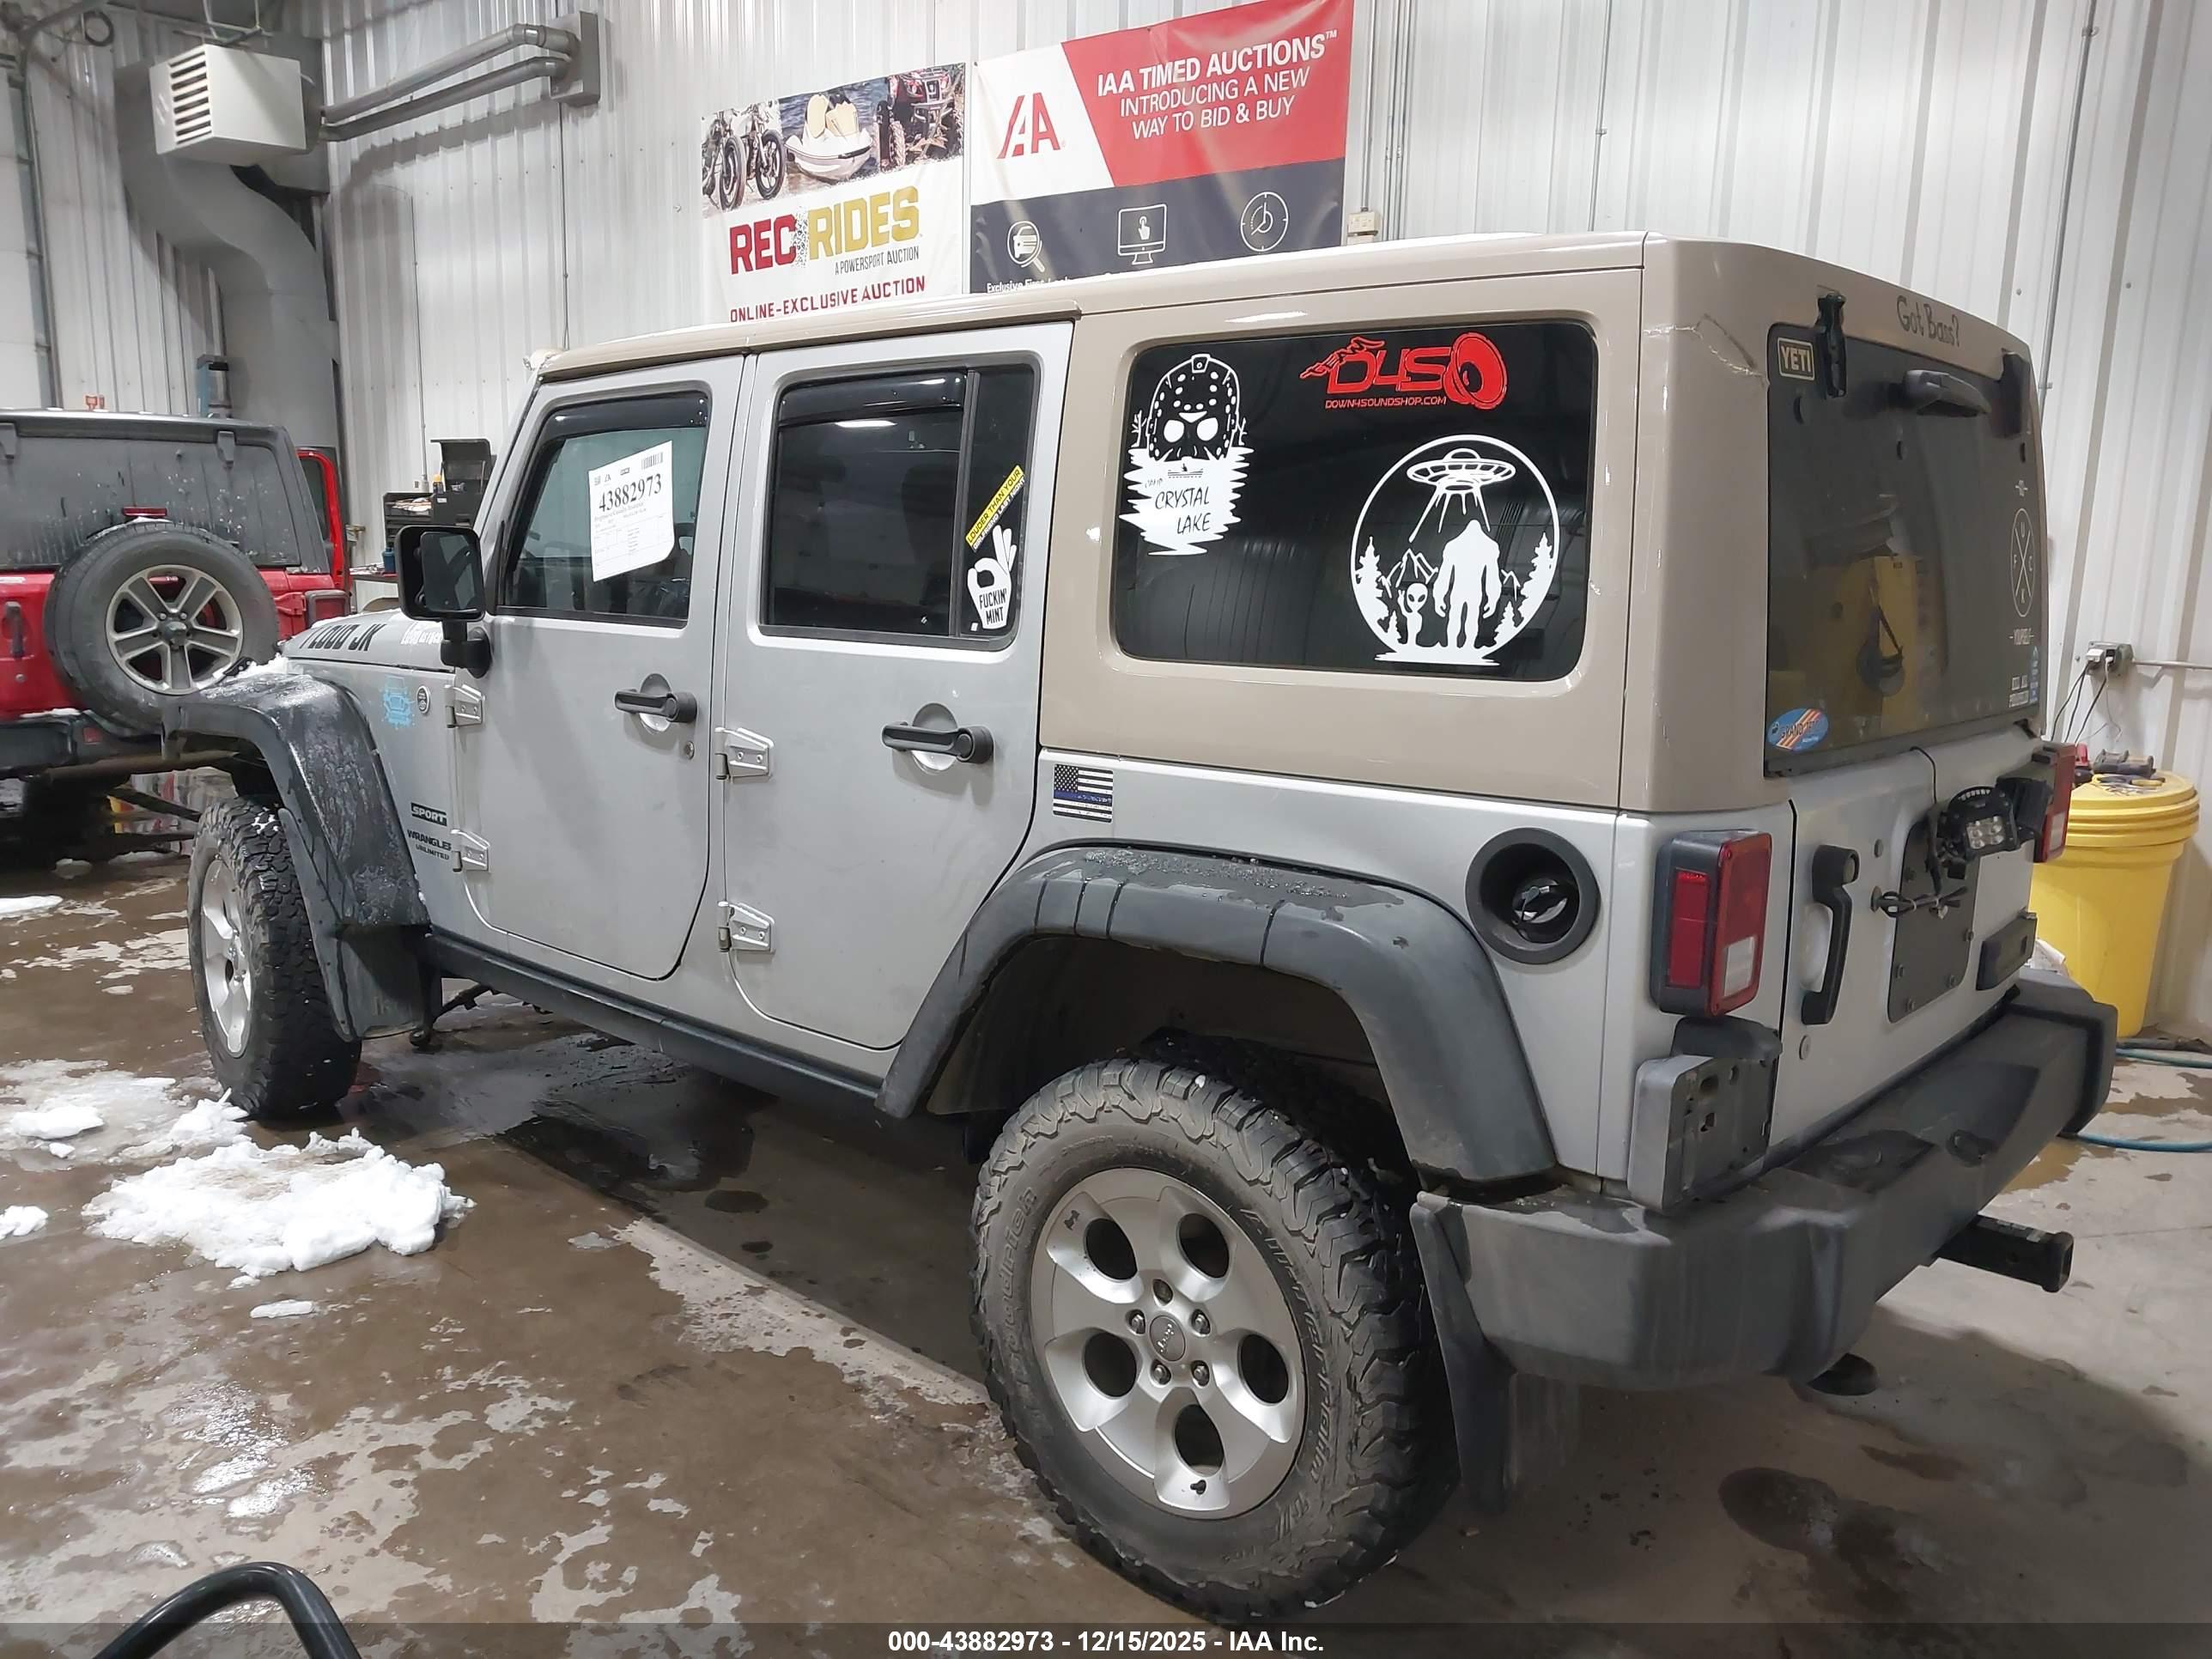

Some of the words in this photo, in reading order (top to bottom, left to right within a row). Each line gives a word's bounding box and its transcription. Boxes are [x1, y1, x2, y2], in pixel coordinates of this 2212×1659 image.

[1097, 71, 1135, 97] IAA
[1139, 58, 1200, 89] TIMED
[1120, 78, 1238, 118] INTRODUCING
[1243, 75, 1257, 94] A
[1261, 66, 1310, 91] NEW
[1132, 116, 1169, 140] WAY
[1172, 111, 1194, 132] TO
[1200, 105, 1230, 129] BID
[1236, 104, 1250, 123] &
[1256, 94, 1295, 121] BUY
[730, 214, 797, 275] REC
[808, 185, 919, 261] RIDES
[835, 263, 841, 275] A
[840, 252, 884, 274] POWERSPORT
[887, 246, 920, 264] AUCTION
[730, 288, 858, 323] ONLINE-EXCLUSIVE
[861, 276, 926, 302] AUCTION
[1896, 295, 1923, 337] Got
[1923, 303, 1960, 348] Bass?
[1780, 345, 1812, 373] YETI
[1325, 396, 1447, 410] DOWN4SOUNDSHOP.COM
[599, 473, 662, 513] 43882973
[967, 513, 989, 543] LOUDER
[988, 492, 1006, 514] THAN
[1003, 469, 1022, 490] YOUR
[997, 498, 1012, 515] LAST
[1010, 476, 1026, 498] NIGHT
[1155, 486, 1210, 510] CRYSTAL
[1176, 513, 1212, 534] LAKE
[979, 587, 1007, 610] FUCKIN'
[985, 606, 1004, 625] MINT
[307, 624, 361, 650] LOUD
[348, 624, 387, 651] JK
[412, 805, 447, 823] SPORT
